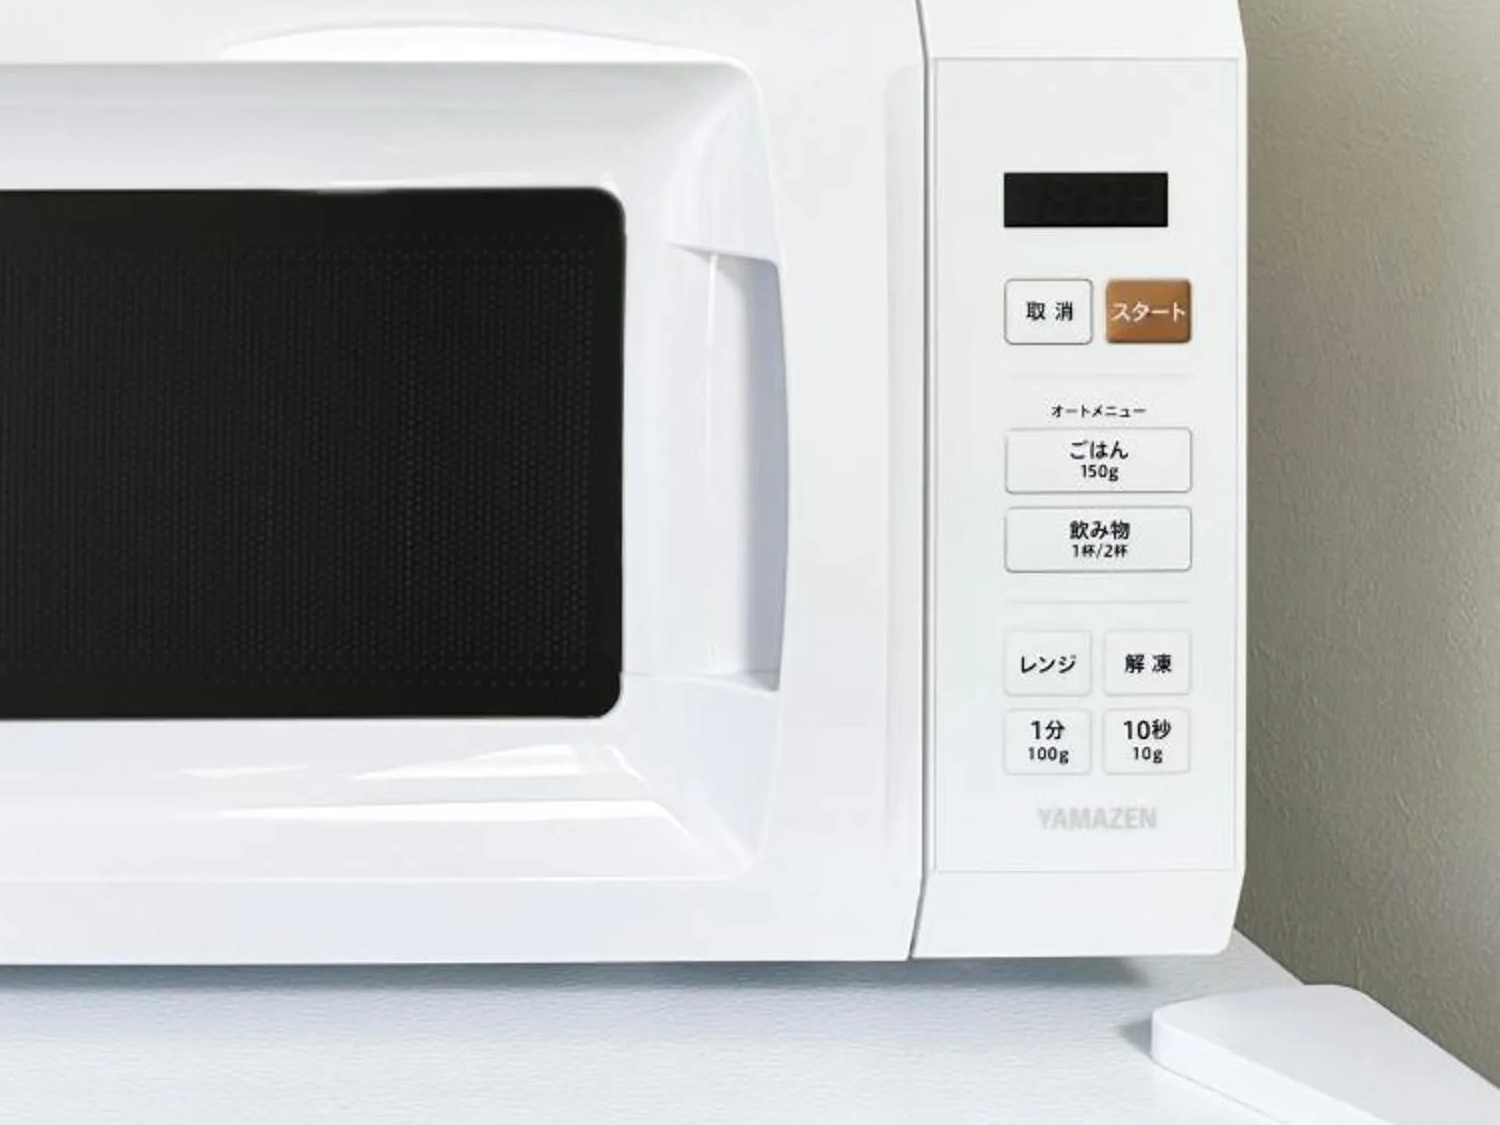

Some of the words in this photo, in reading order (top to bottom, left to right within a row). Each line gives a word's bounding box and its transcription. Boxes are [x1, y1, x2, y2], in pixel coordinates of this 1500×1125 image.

[1025, 300, 1074, 322] 取消
[1110, 301, 1187, 323] スタート
[1050, 403, 1147, 419] オートメニュー
[1068, 439, 1129, 461] ごはん
[1079, 463, 1120, 482] 150g
[1069, 520, 1131, 541] 飲み物
[1071, 544, 1128, 559] 1杯/2杯
[1020, 654, 1077, 675] レンジ
[1029, 720, 1066, 742] 1分
[1123, 719, 1172, 742] 10秒
[1027, 746, 1070, 764] 100g
[1132, 746, 1164, 764] 10g
[1037, 806, 1158, 830] YAMAZEN
